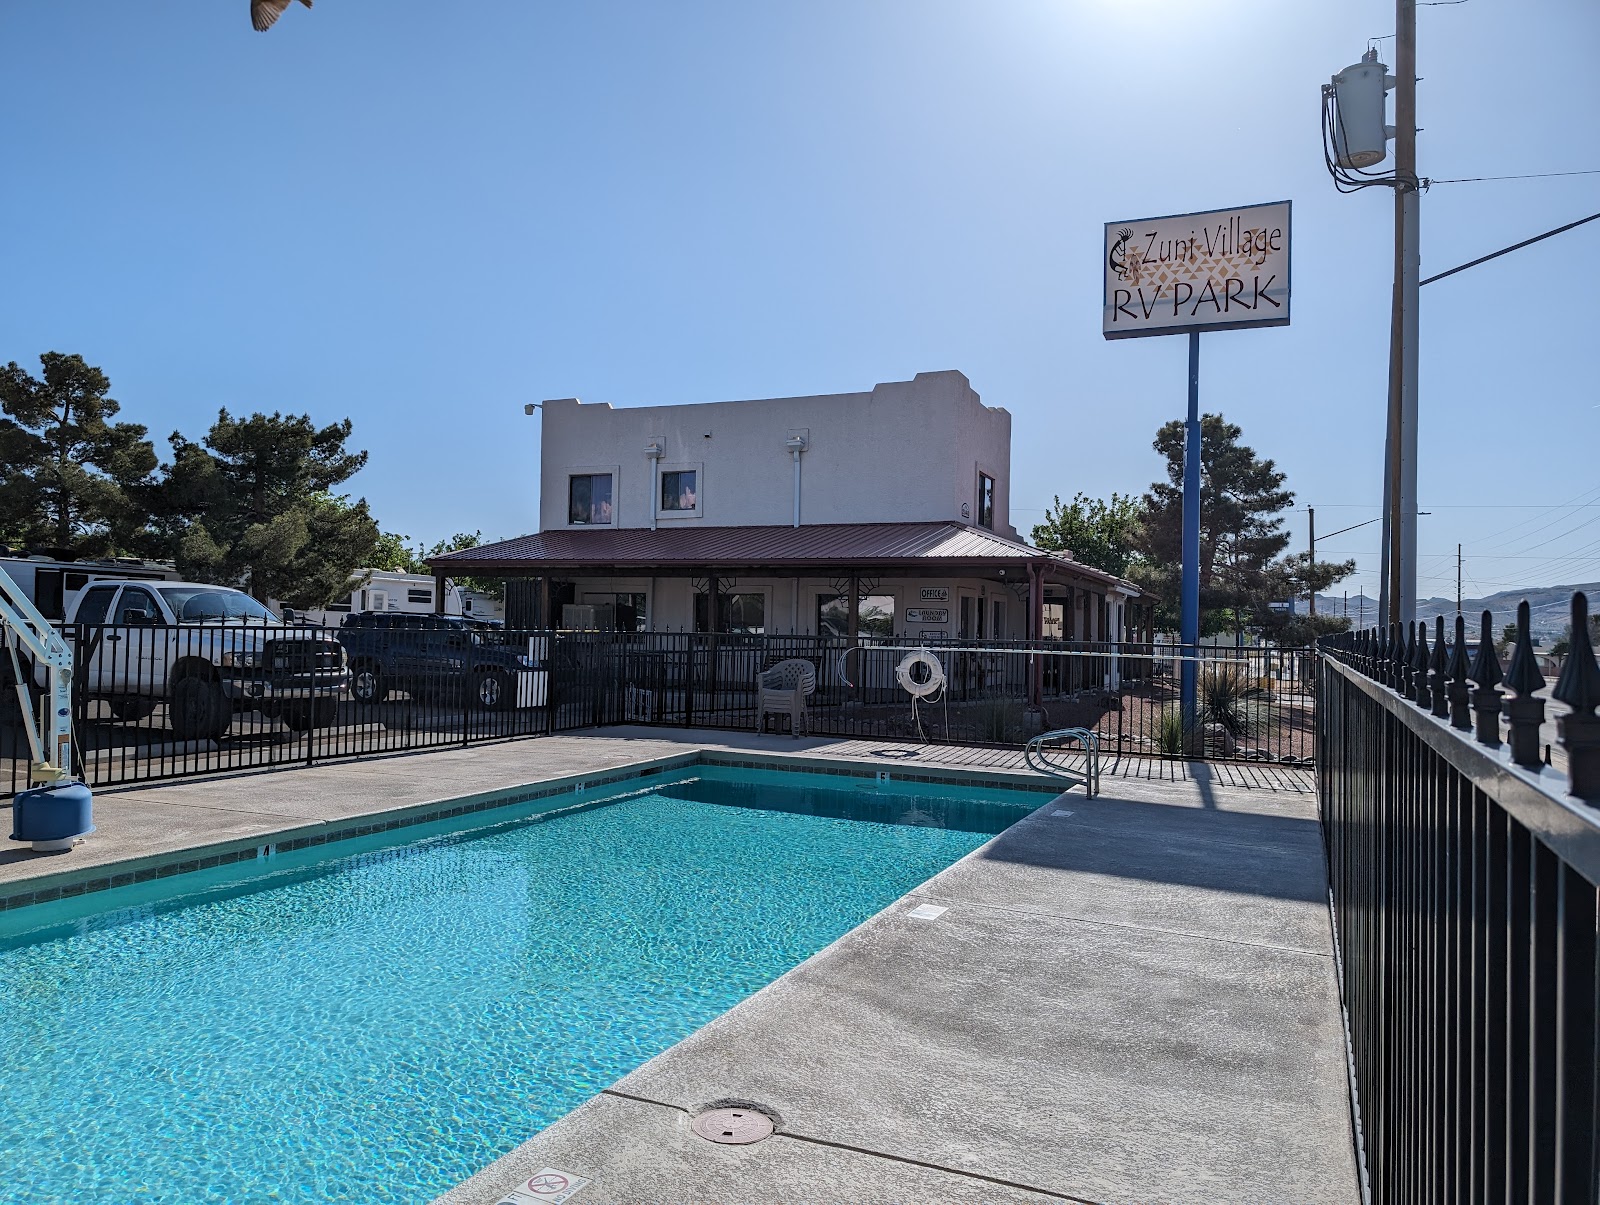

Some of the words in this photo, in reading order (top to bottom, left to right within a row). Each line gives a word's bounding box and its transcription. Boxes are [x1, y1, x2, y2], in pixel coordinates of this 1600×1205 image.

[1141, 230, 1195, 265] Zuni
[1203, 216, 1282, 266] Village
[1112, 285, 1162, 322] RV
[1173, 274, 1281, 317] PARK
[921, 589, 941, 598] OFFICE
[507, 1192, 523, 1202] FT
[552, 1191, 566, 1203] NO
[564, 1178, 587, 1195] DIVING
